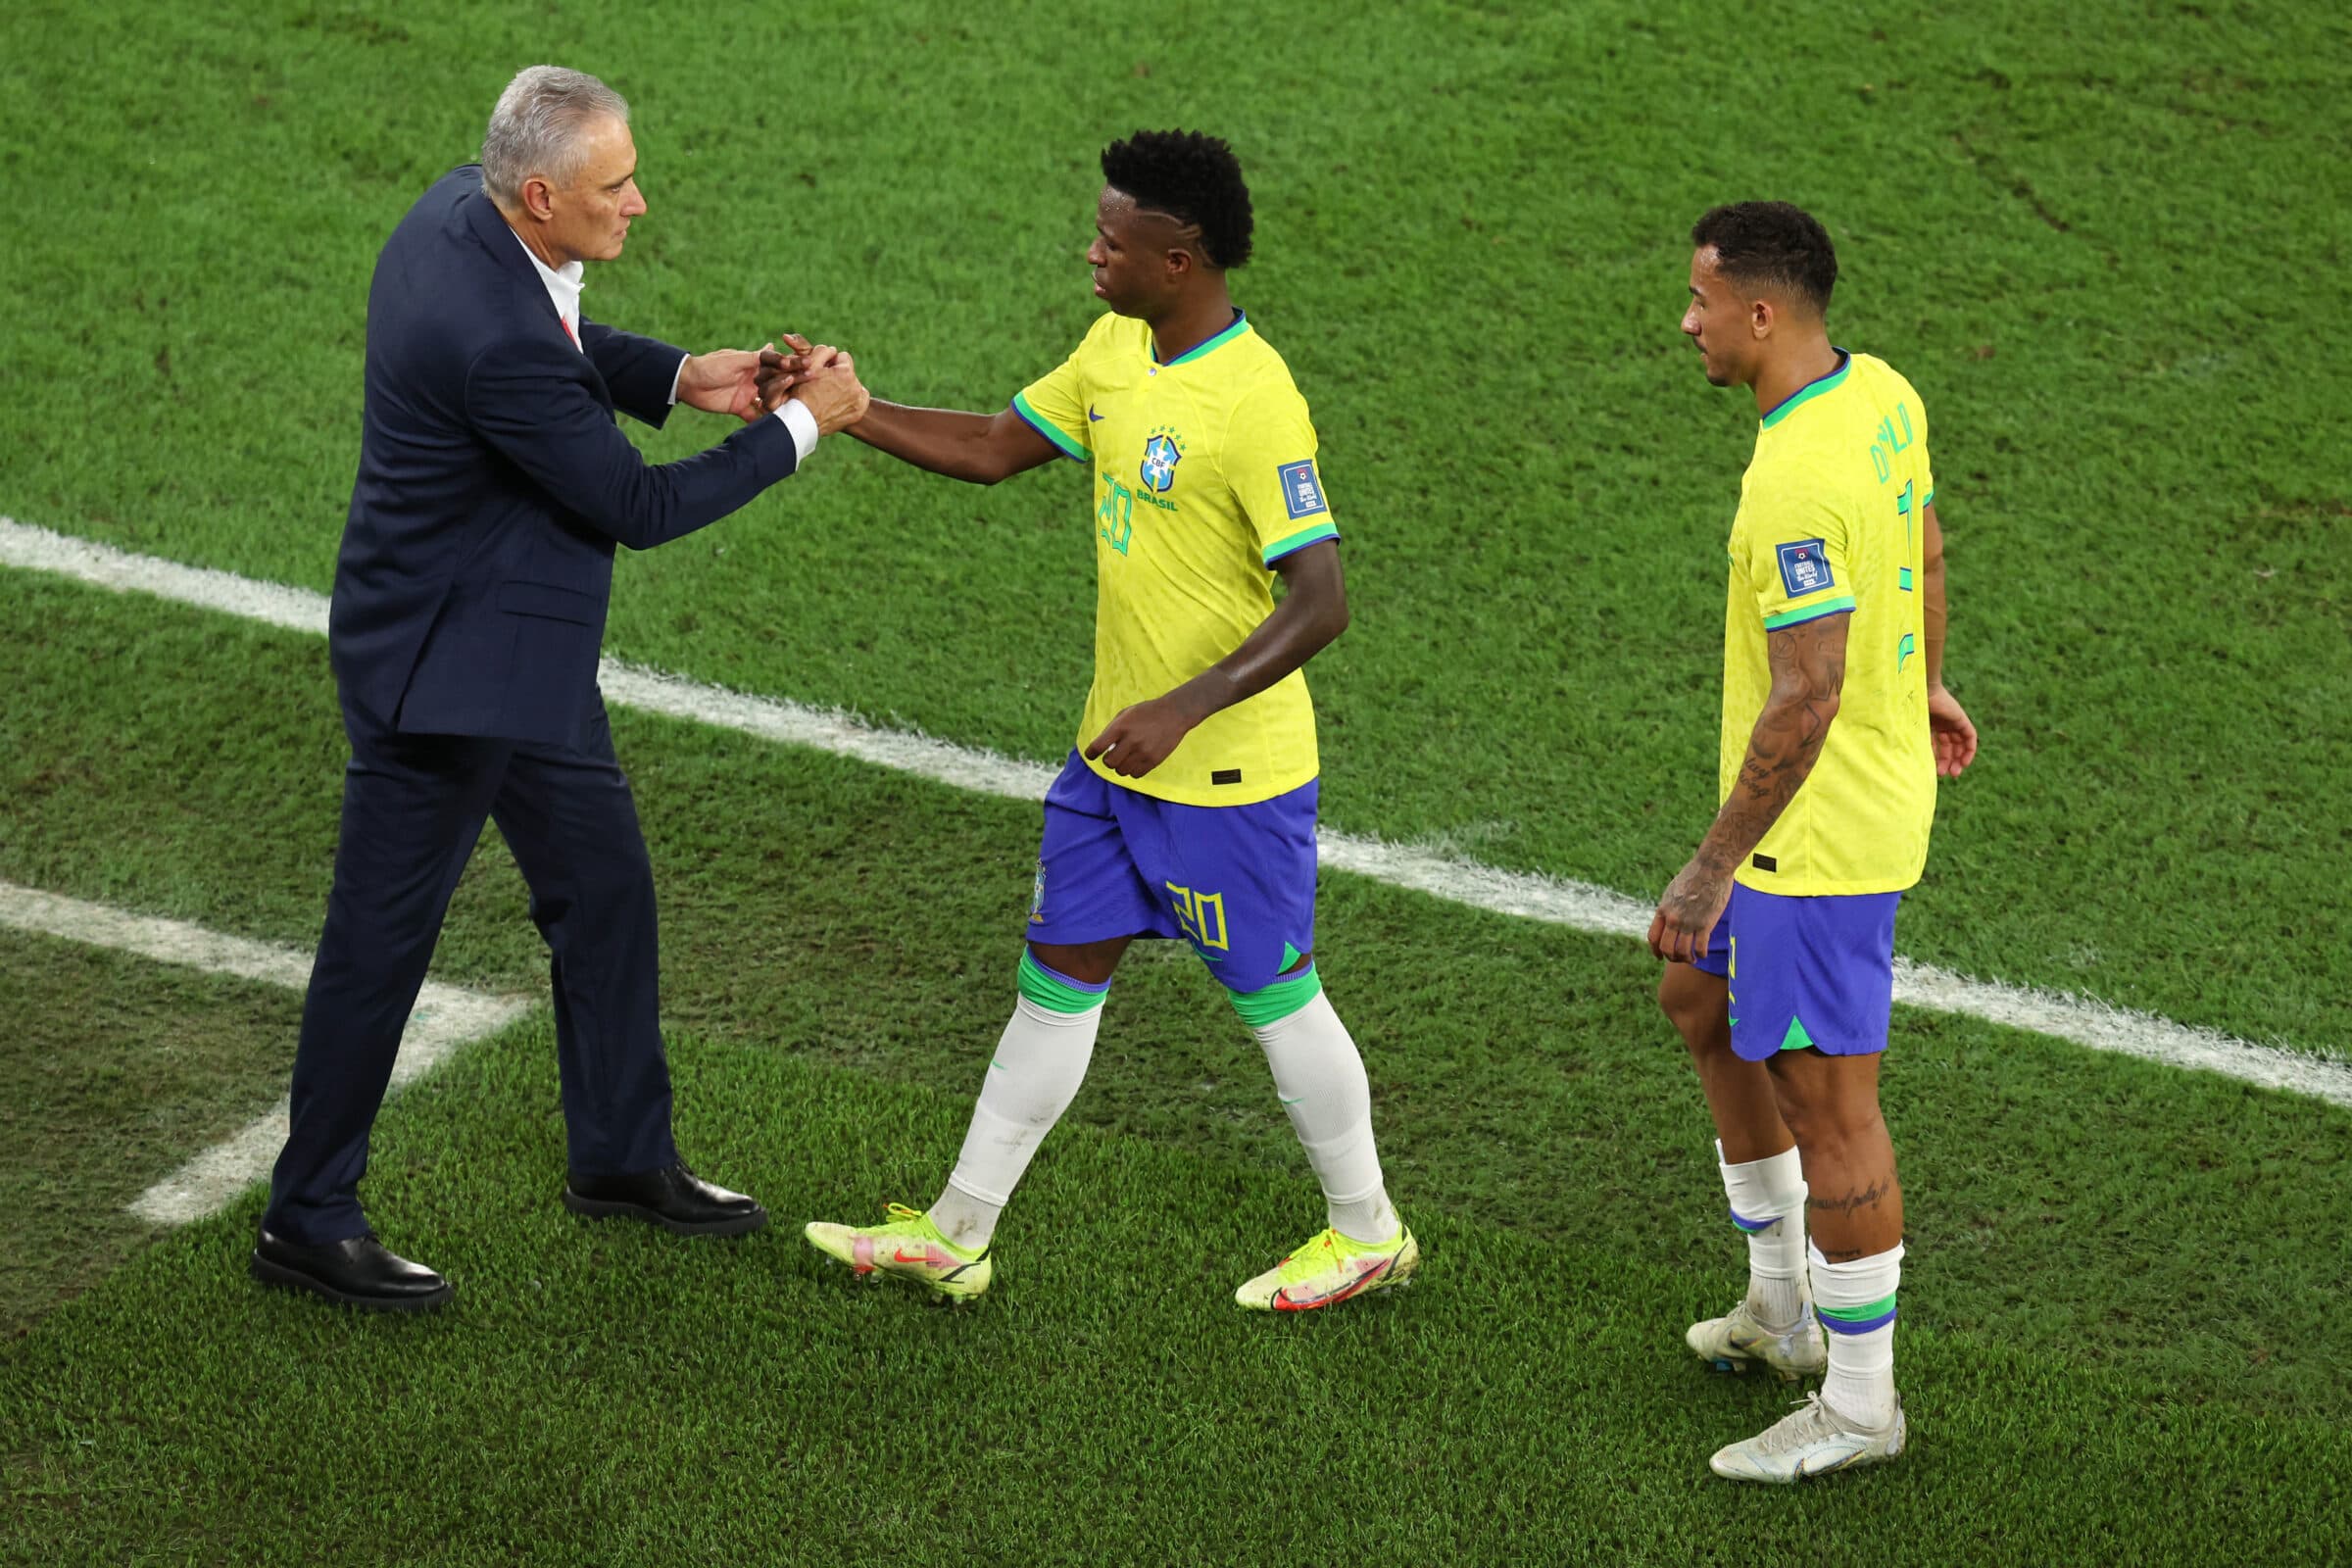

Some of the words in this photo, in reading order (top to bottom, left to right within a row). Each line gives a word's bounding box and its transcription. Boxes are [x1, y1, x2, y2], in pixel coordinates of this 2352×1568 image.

[1152, 457, 1165, 468] CBF
[1137, 489, 1179, 512] BRASIL
[1165, 880, 1229, 952] 20
